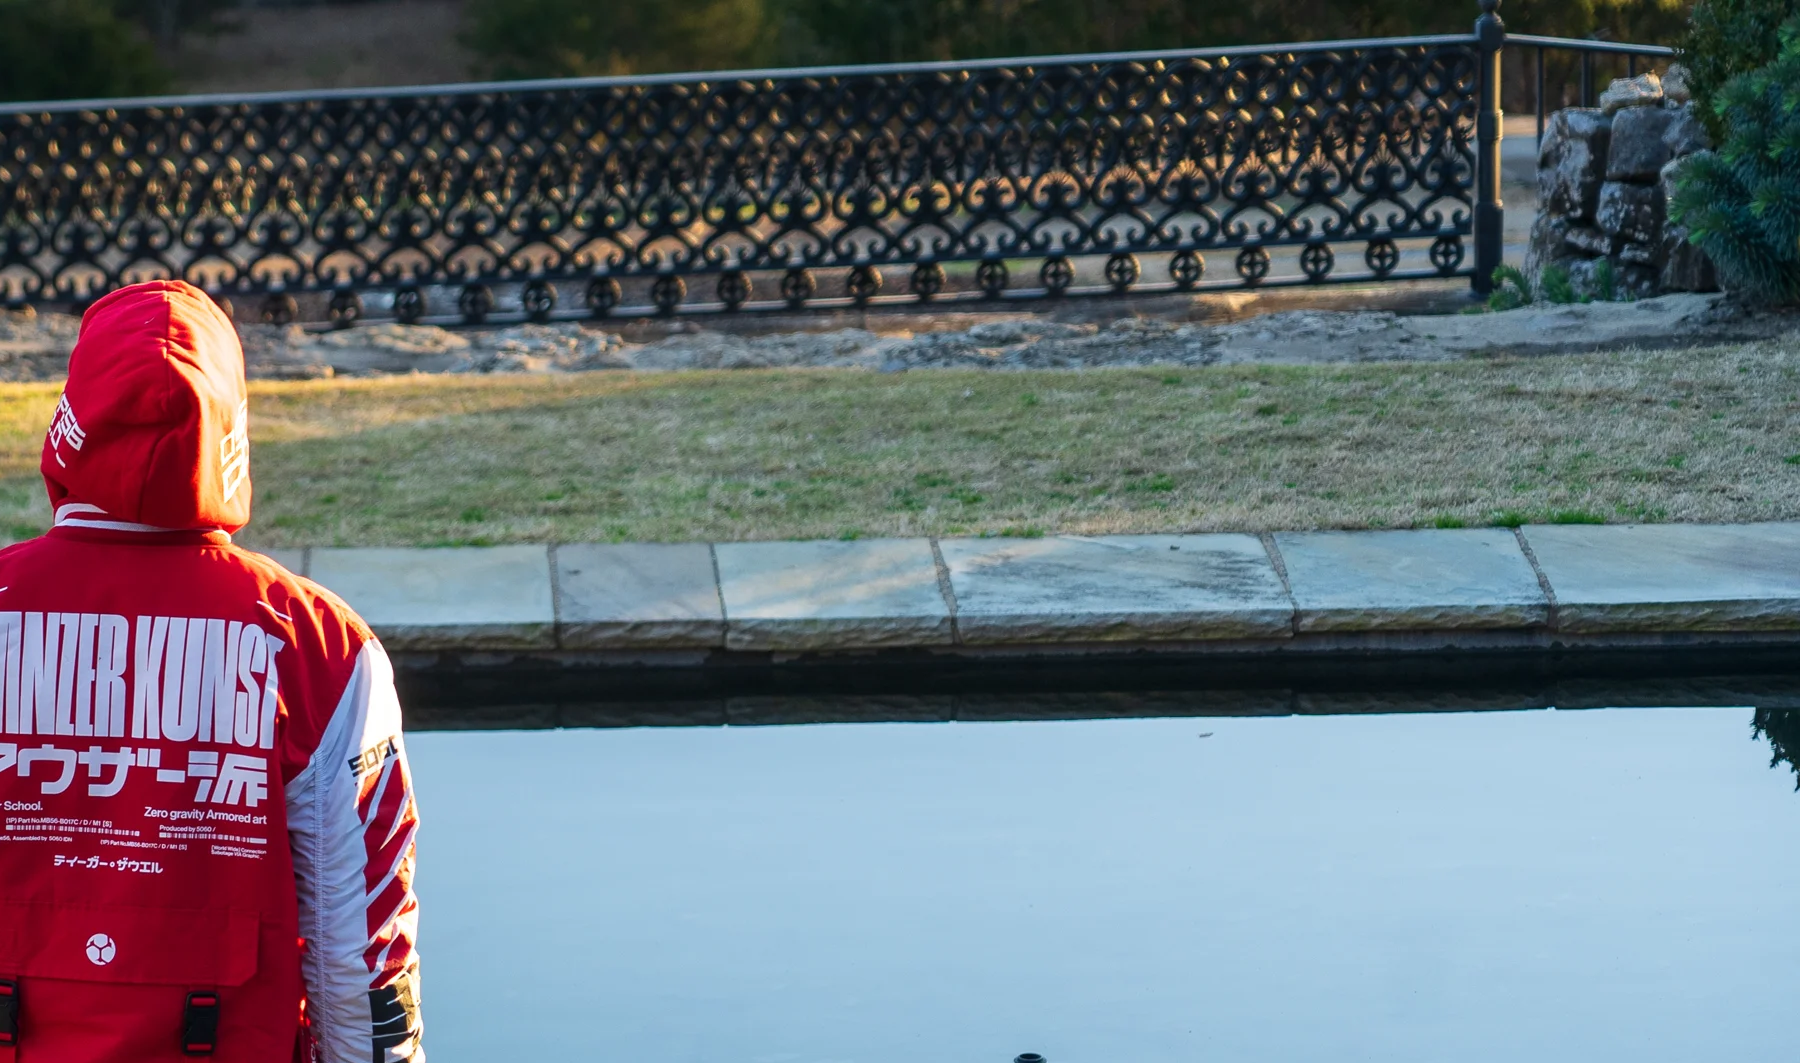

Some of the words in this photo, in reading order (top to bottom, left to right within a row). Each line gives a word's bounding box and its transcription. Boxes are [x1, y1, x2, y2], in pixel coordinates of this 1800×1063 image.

[131, 615, 286, 749] KUNST
[4, 801, 43, 811] School.
[144, 806, 168, 818] Zero
[170, 810, 204, 821] gravity
[206, 809, 251, 823] Armored
[252, 815, 267, 824] art
